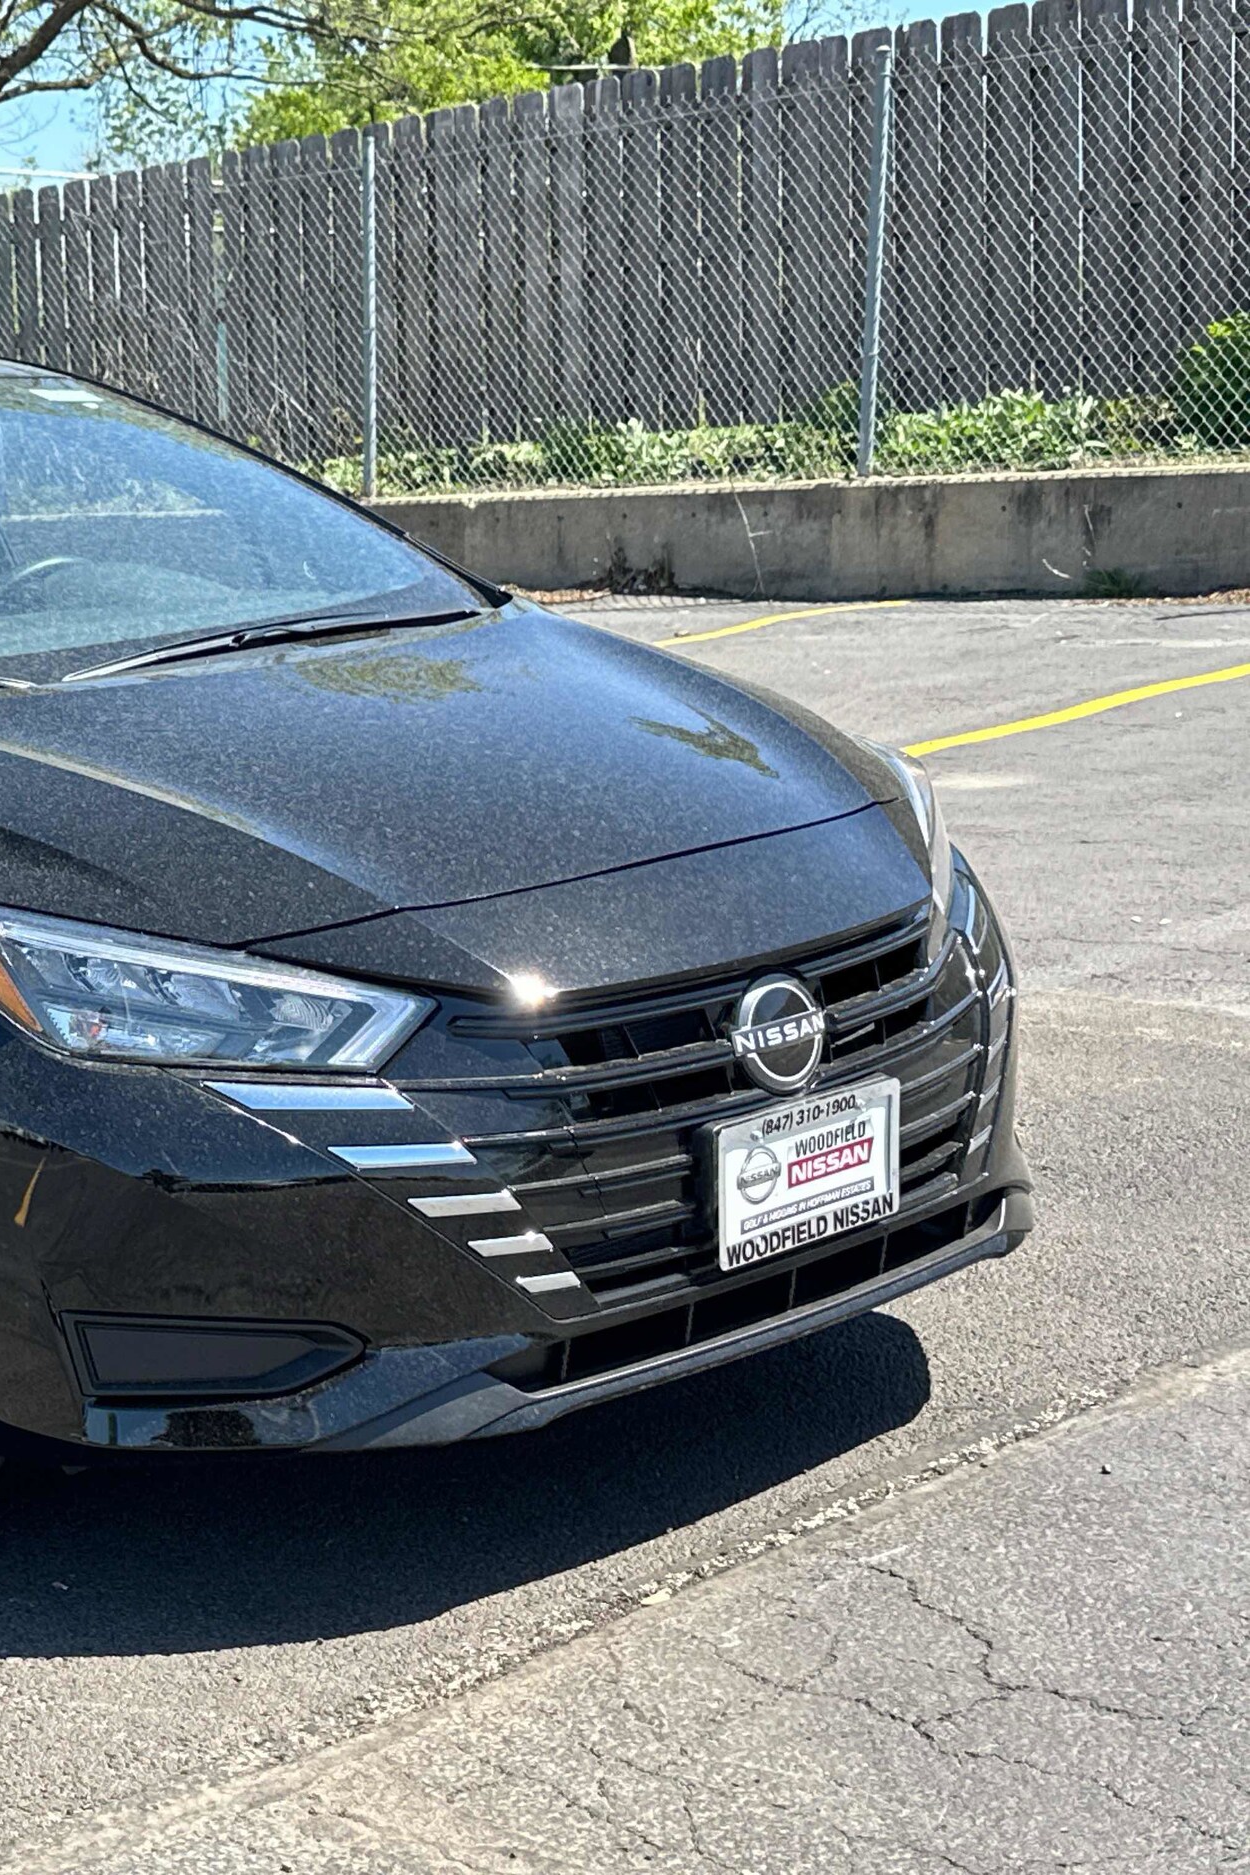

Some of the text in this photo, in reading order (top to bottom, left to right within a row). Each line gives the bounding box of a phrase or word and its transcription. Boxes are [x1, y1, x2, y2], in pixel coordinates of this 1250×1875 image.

[735, 1012, 825, 1052] NISSAN
[762, 1094, 856, 1136] (847) 310-1900
[795, 1121, 866, 1158] WOODFIELD
[739, 1165, 781, 1185] NISSAN
[791, 1142, 871, 1184] NISSAN
[726, 1195, 894, 1267] WOODFIELD NISSAN
